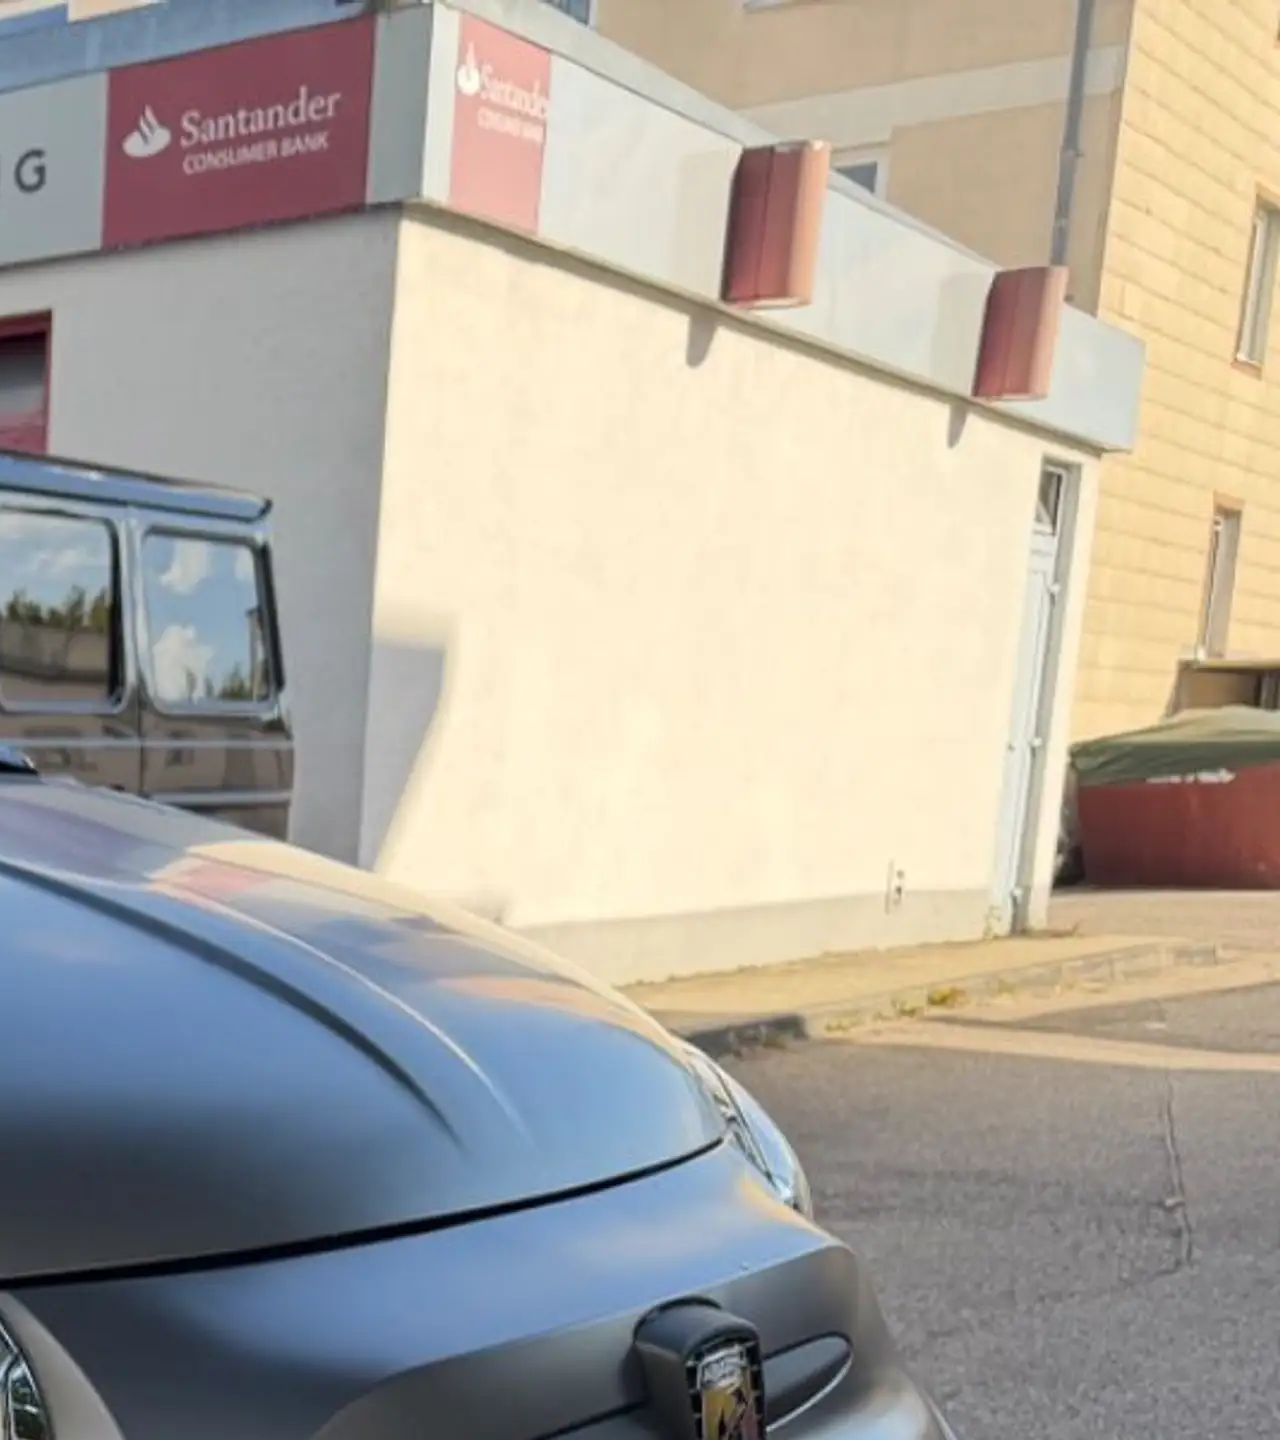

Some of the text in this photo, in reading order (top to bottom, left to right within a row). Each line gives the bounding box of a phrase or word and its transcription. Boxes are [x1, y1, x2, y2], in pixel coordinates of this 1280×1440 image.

[180, 84, 341, 148] Santander
[182, 131, 330, 176] CONSUMER BANK
